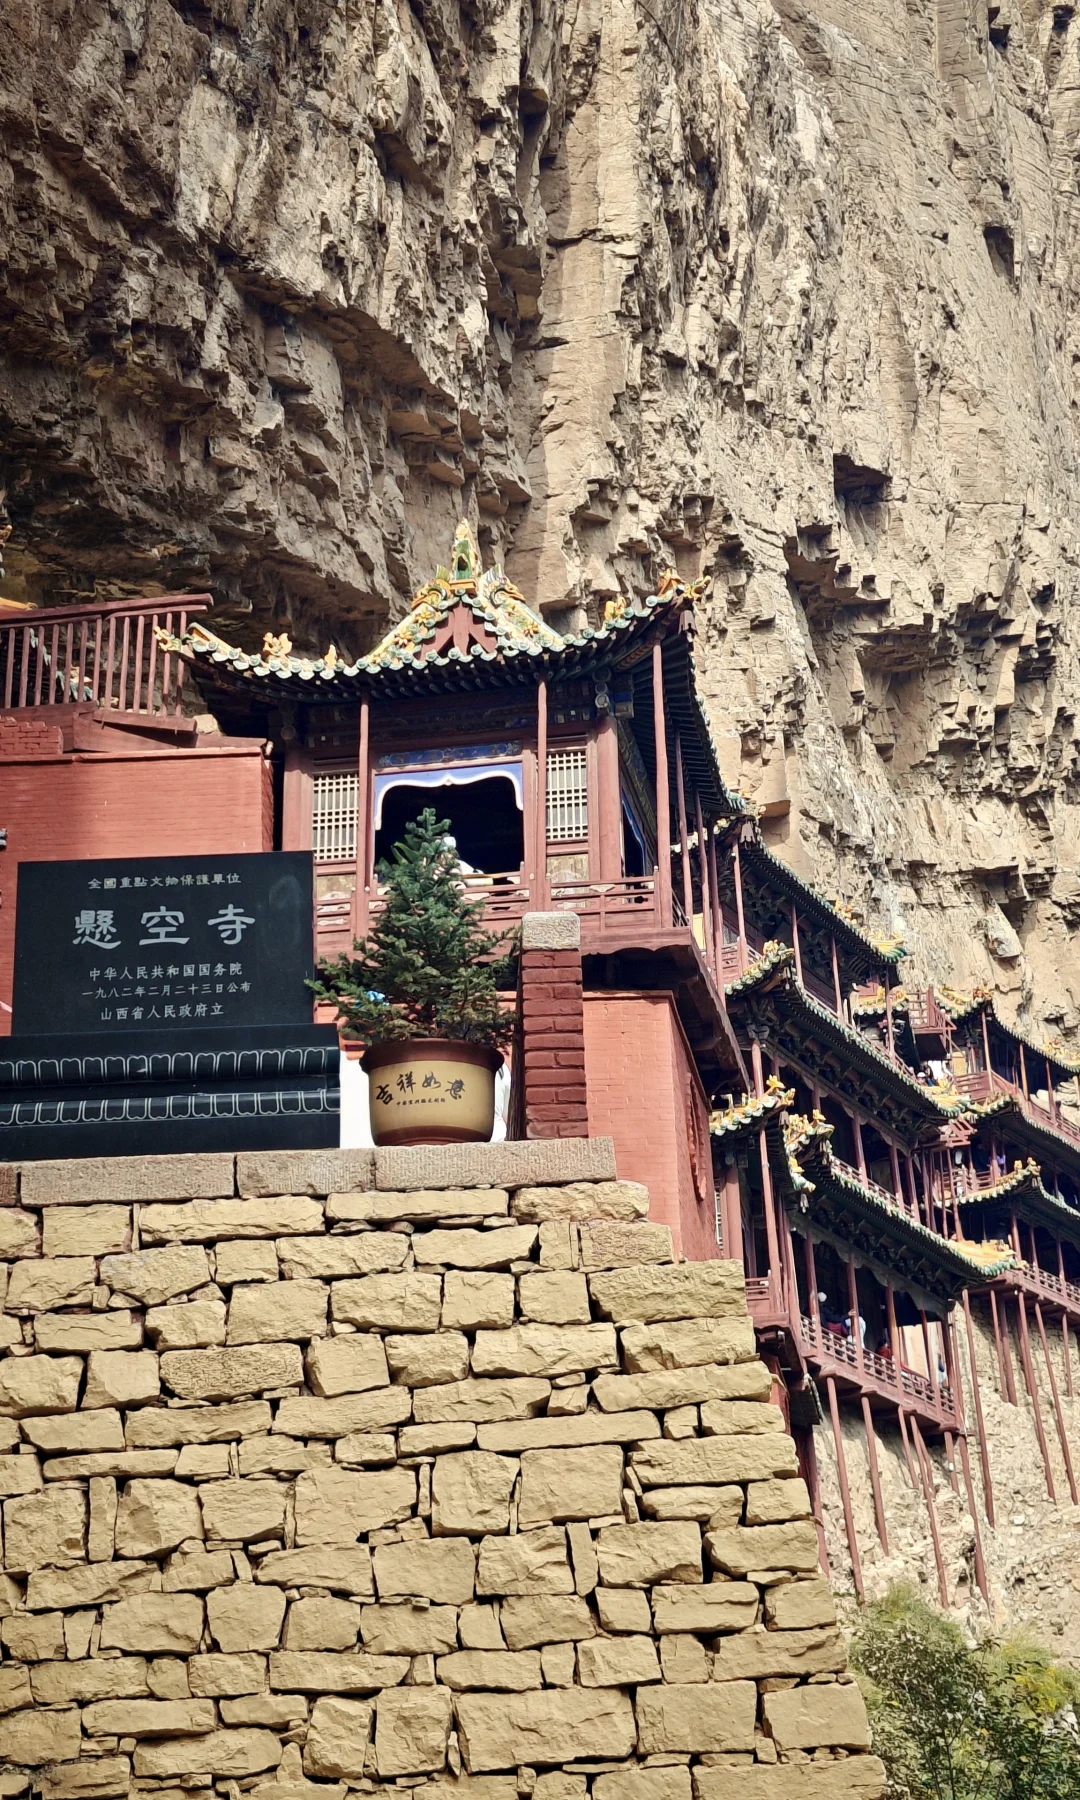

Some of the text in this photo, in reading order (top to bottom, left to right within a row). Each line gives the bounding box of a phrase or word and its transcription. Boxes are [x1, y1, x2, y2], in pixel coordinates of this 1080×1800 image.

[72, 903, 256, 950] 懸空寺
[89, 962, 243, 982] 中华人民共和国国务院
[81, 981, 252, 1000] 一九八二年二月二十三日公布
[101, 1002, 225, 1021] 山西省人民政府立
